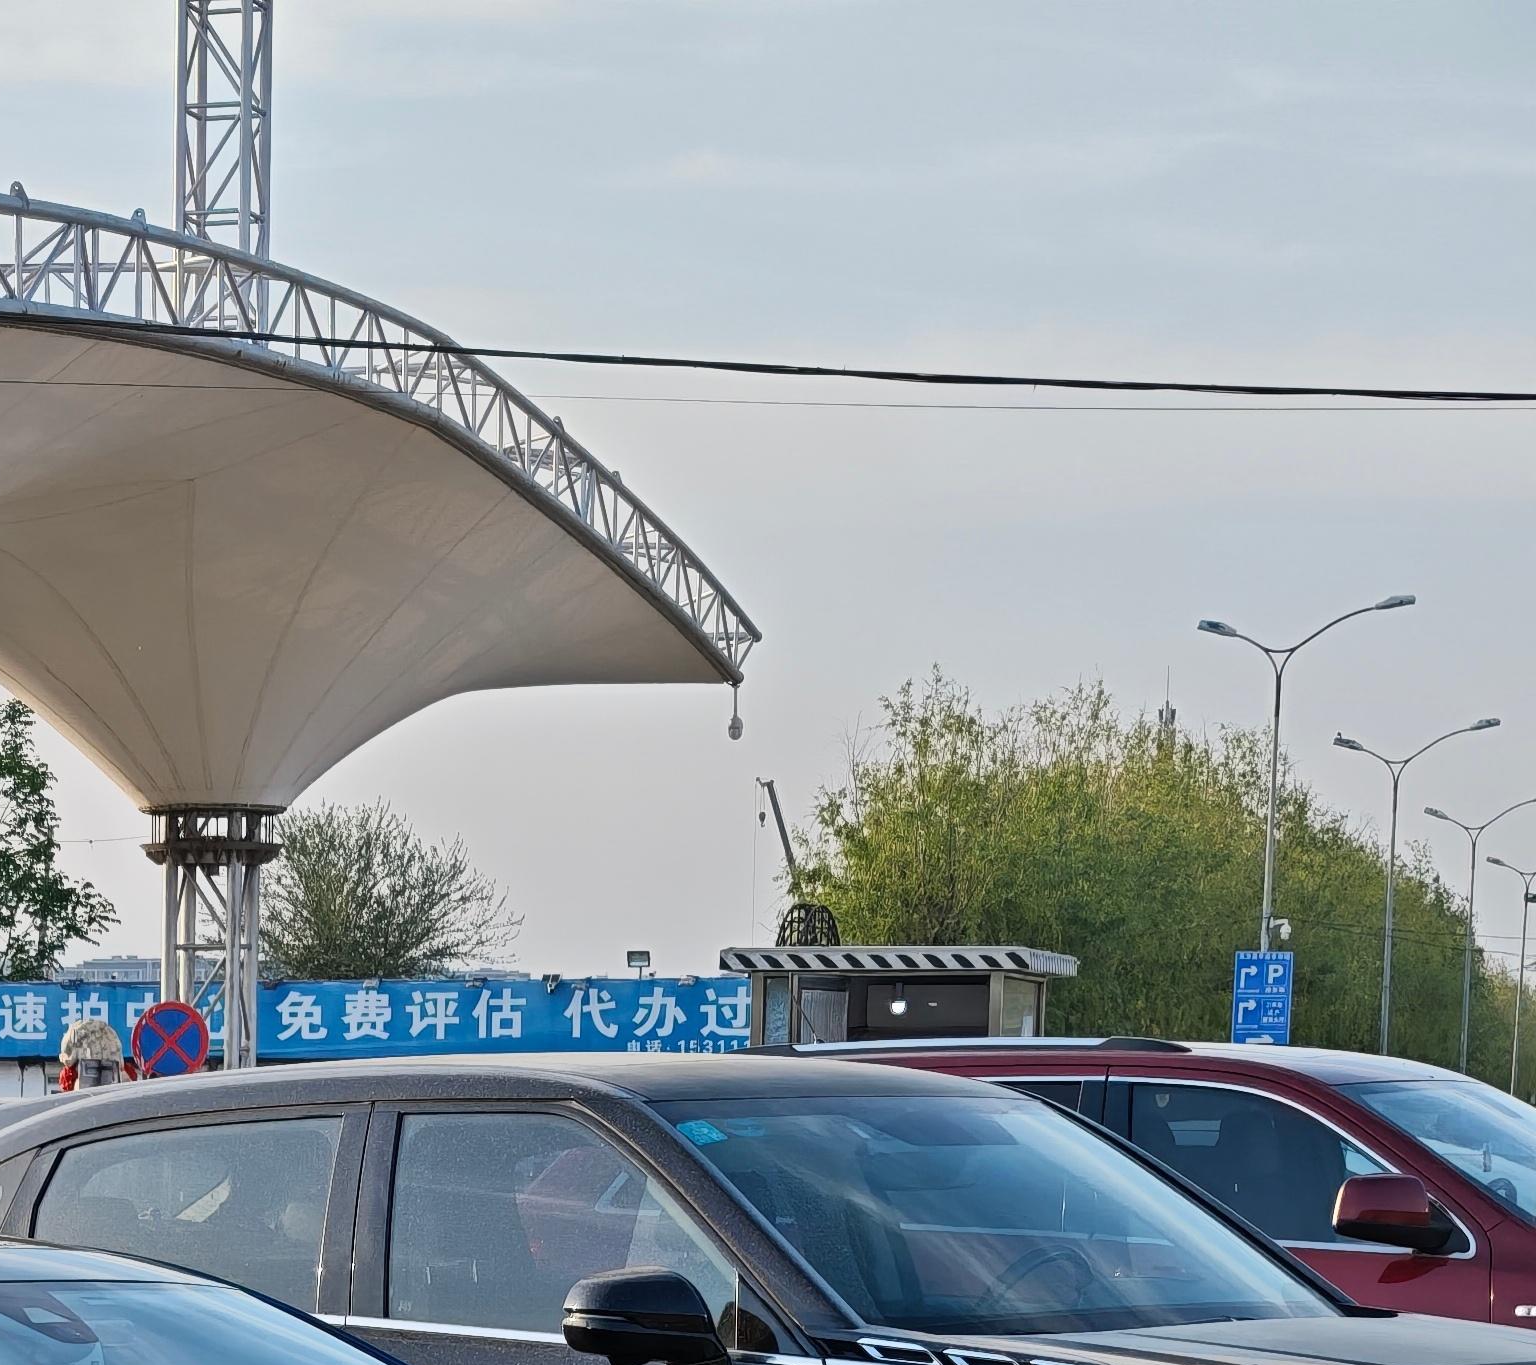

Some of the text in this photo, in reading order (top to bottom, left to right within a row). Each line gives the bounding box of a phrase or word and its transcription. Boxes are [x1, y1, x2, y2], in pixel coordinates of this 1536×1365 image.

[1267, 964, 1284, 984] P
[276, 988, 527, 1041] 免费评估
[564, 987, 751, 1039] 代办过
